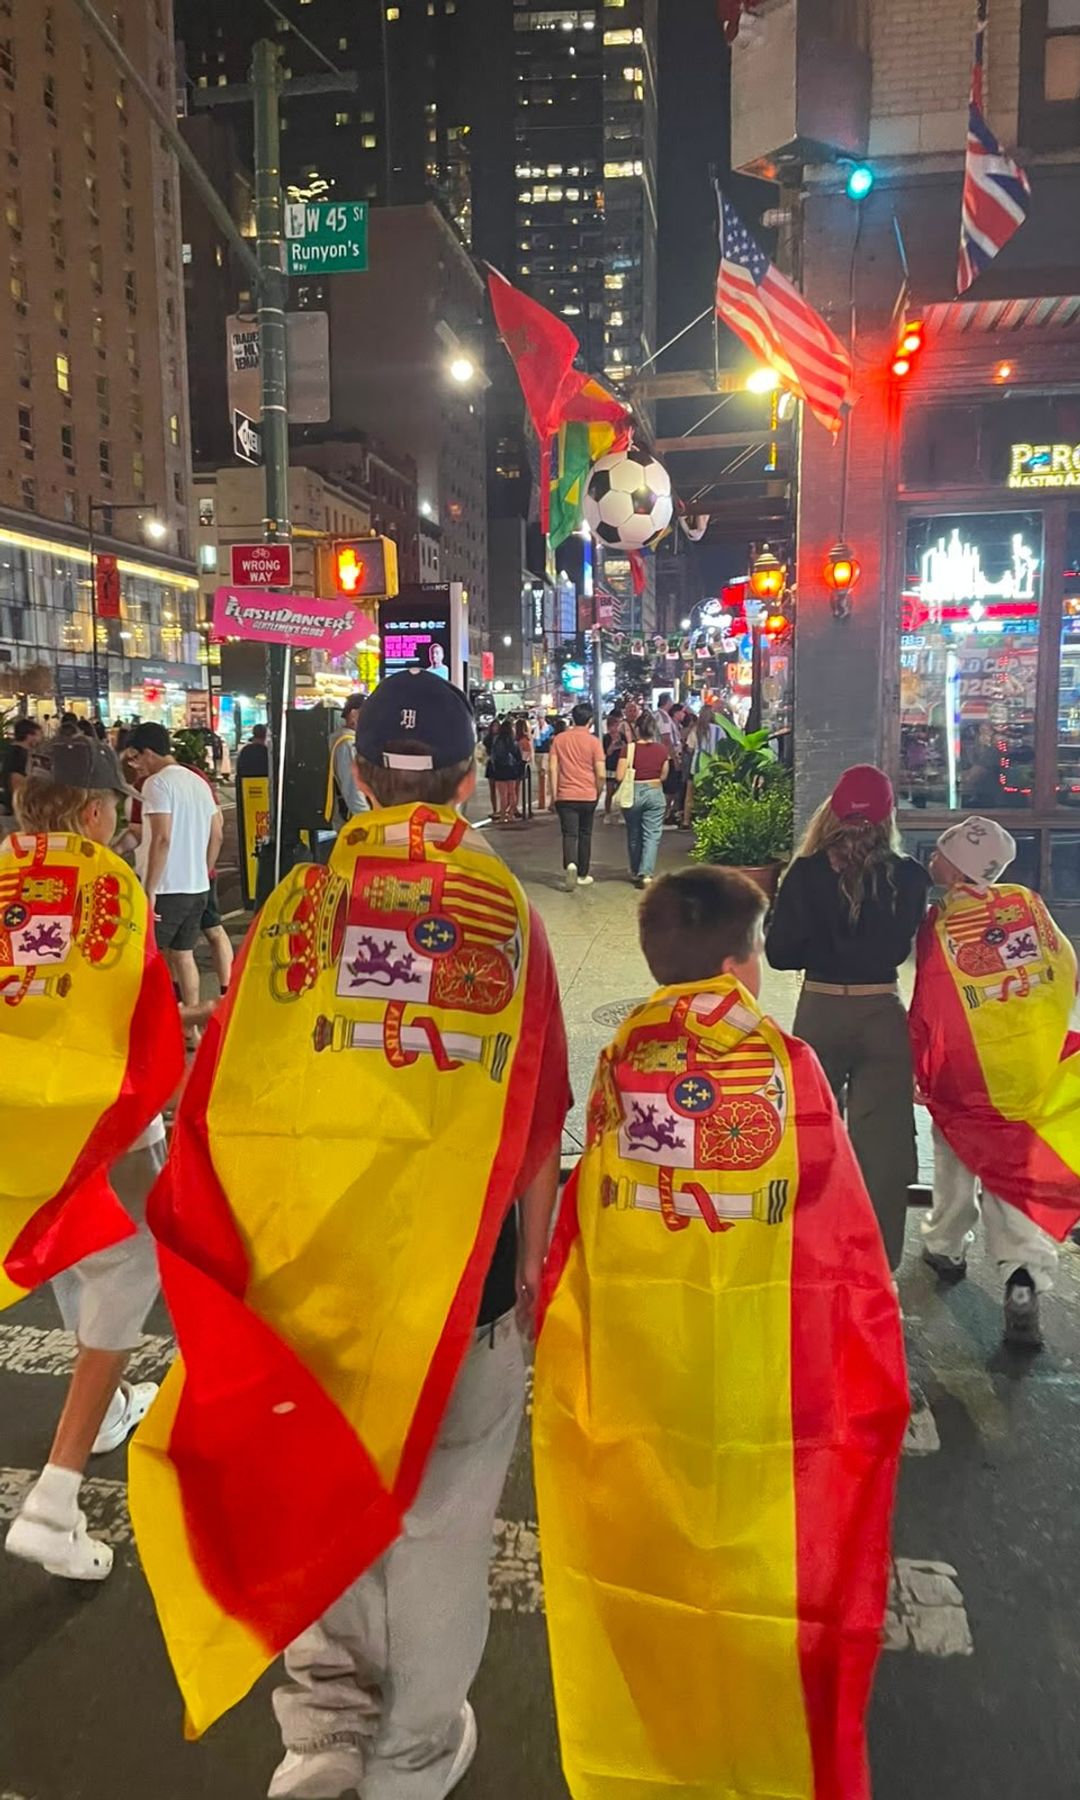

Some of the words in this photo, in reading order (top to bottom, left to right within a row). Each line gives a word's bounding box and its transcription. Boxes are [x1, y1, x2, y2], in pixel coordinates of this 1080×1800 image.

[307, 207, 320, 232] W
[326, 207, 347, 233] 45
[292, 240, 360, 264] Runyon's
[292, 262, 308, 272] Way
[1008, 473, 1064, 489] NASTRO
[242, 559, 281, 571] WRONG
[249, 571, 273, 583] WAY
